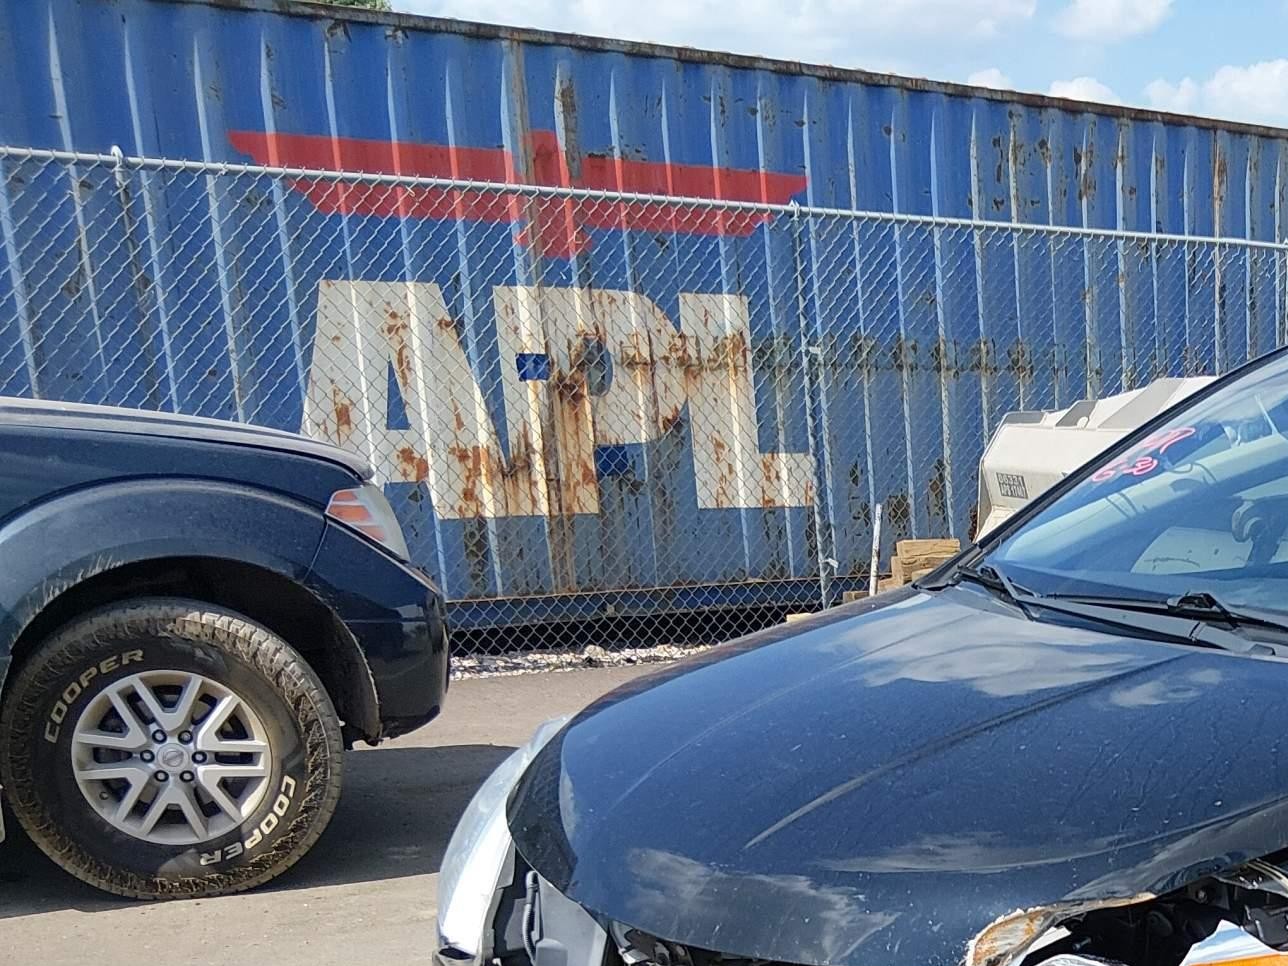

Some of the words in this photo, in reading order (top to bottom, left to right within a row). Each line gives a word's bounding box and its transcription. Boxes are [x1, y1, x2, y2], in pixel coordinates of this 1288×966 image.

[301, 280, 815, 520] APL
[44, 649, 145, 744] COOPER
[200, 775, 297, 866] COOPER
